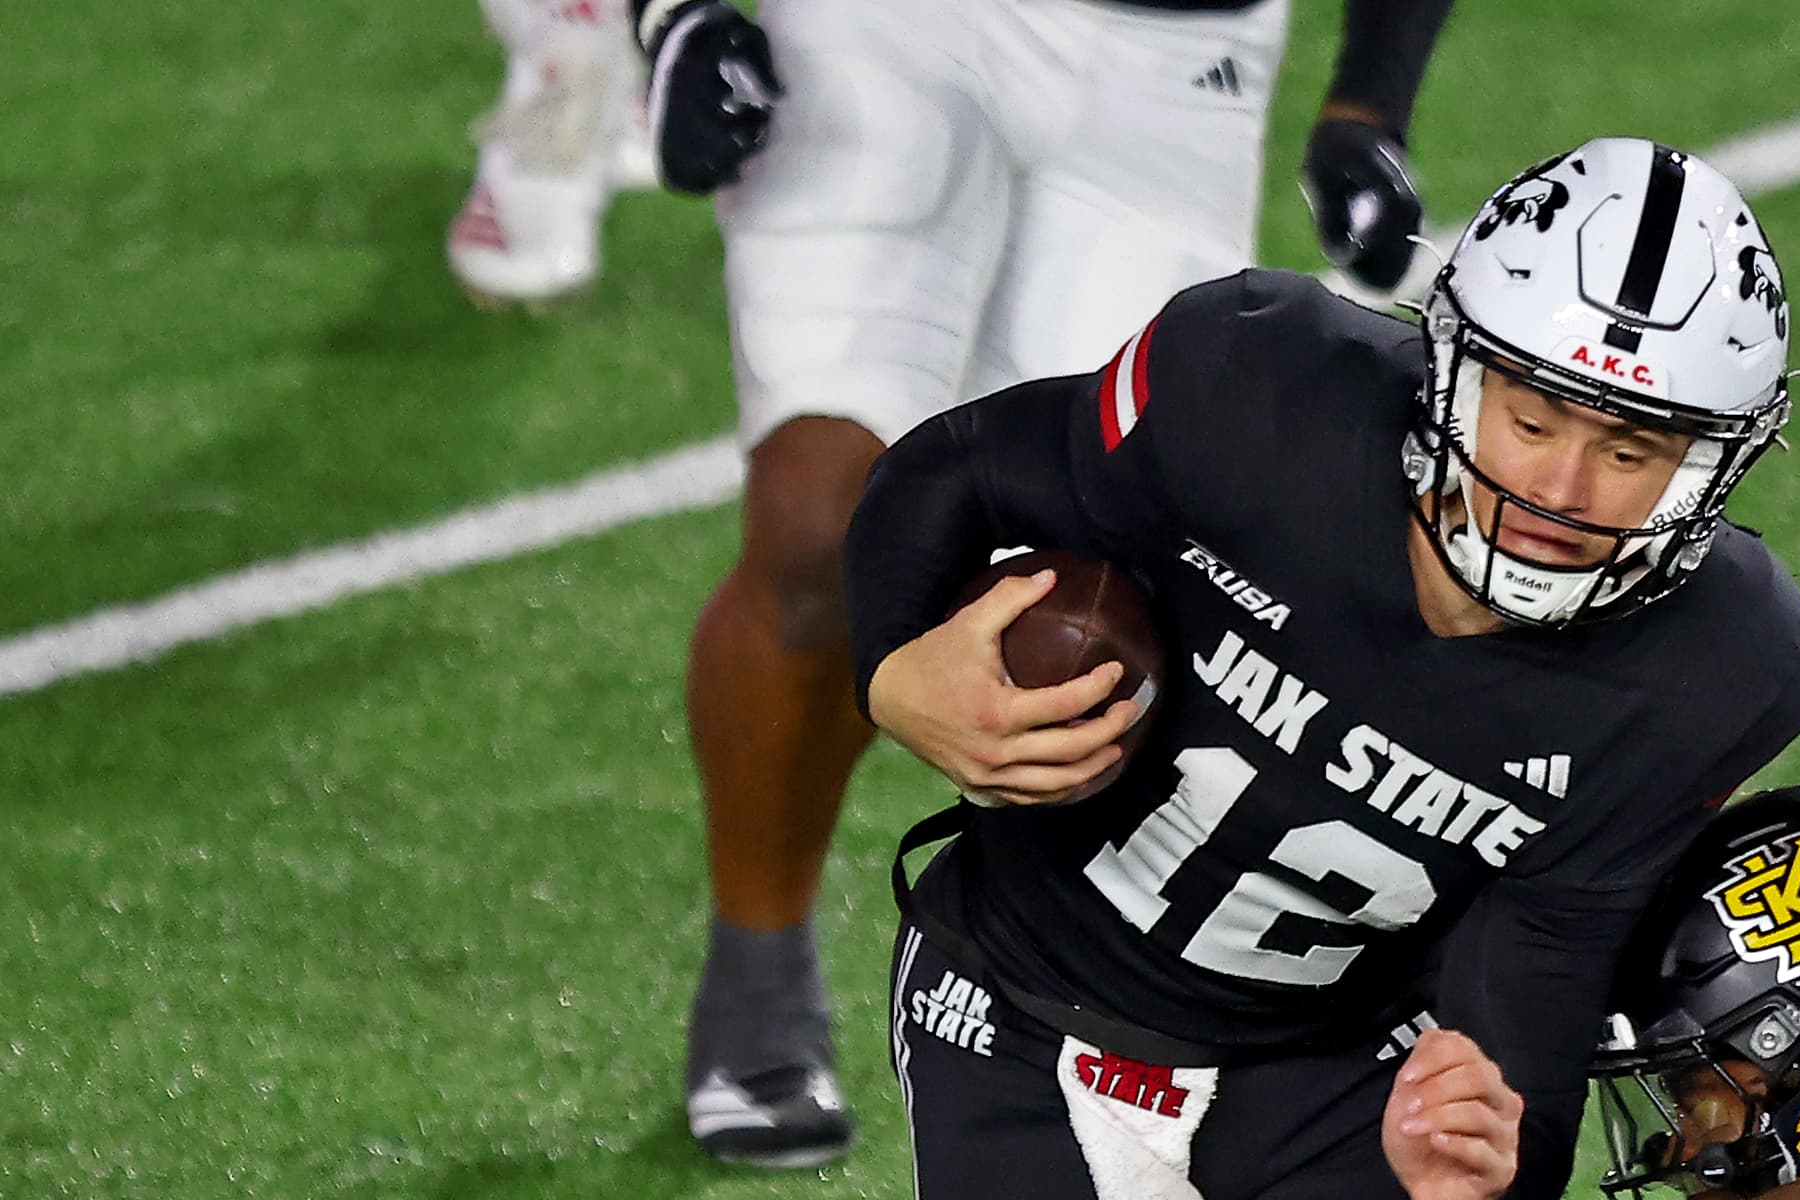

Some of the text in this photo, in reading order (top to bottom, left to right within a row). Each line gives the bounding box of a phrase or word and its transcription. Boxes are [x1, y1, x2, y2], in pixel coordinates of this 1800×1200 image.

[1504, 570, 1553, 592] Riddell
[1193, 630, 1547, 868] JAX STATE
[1083, 746, 1438, 986] 12
[911, 990, 996, 1057] STATE
